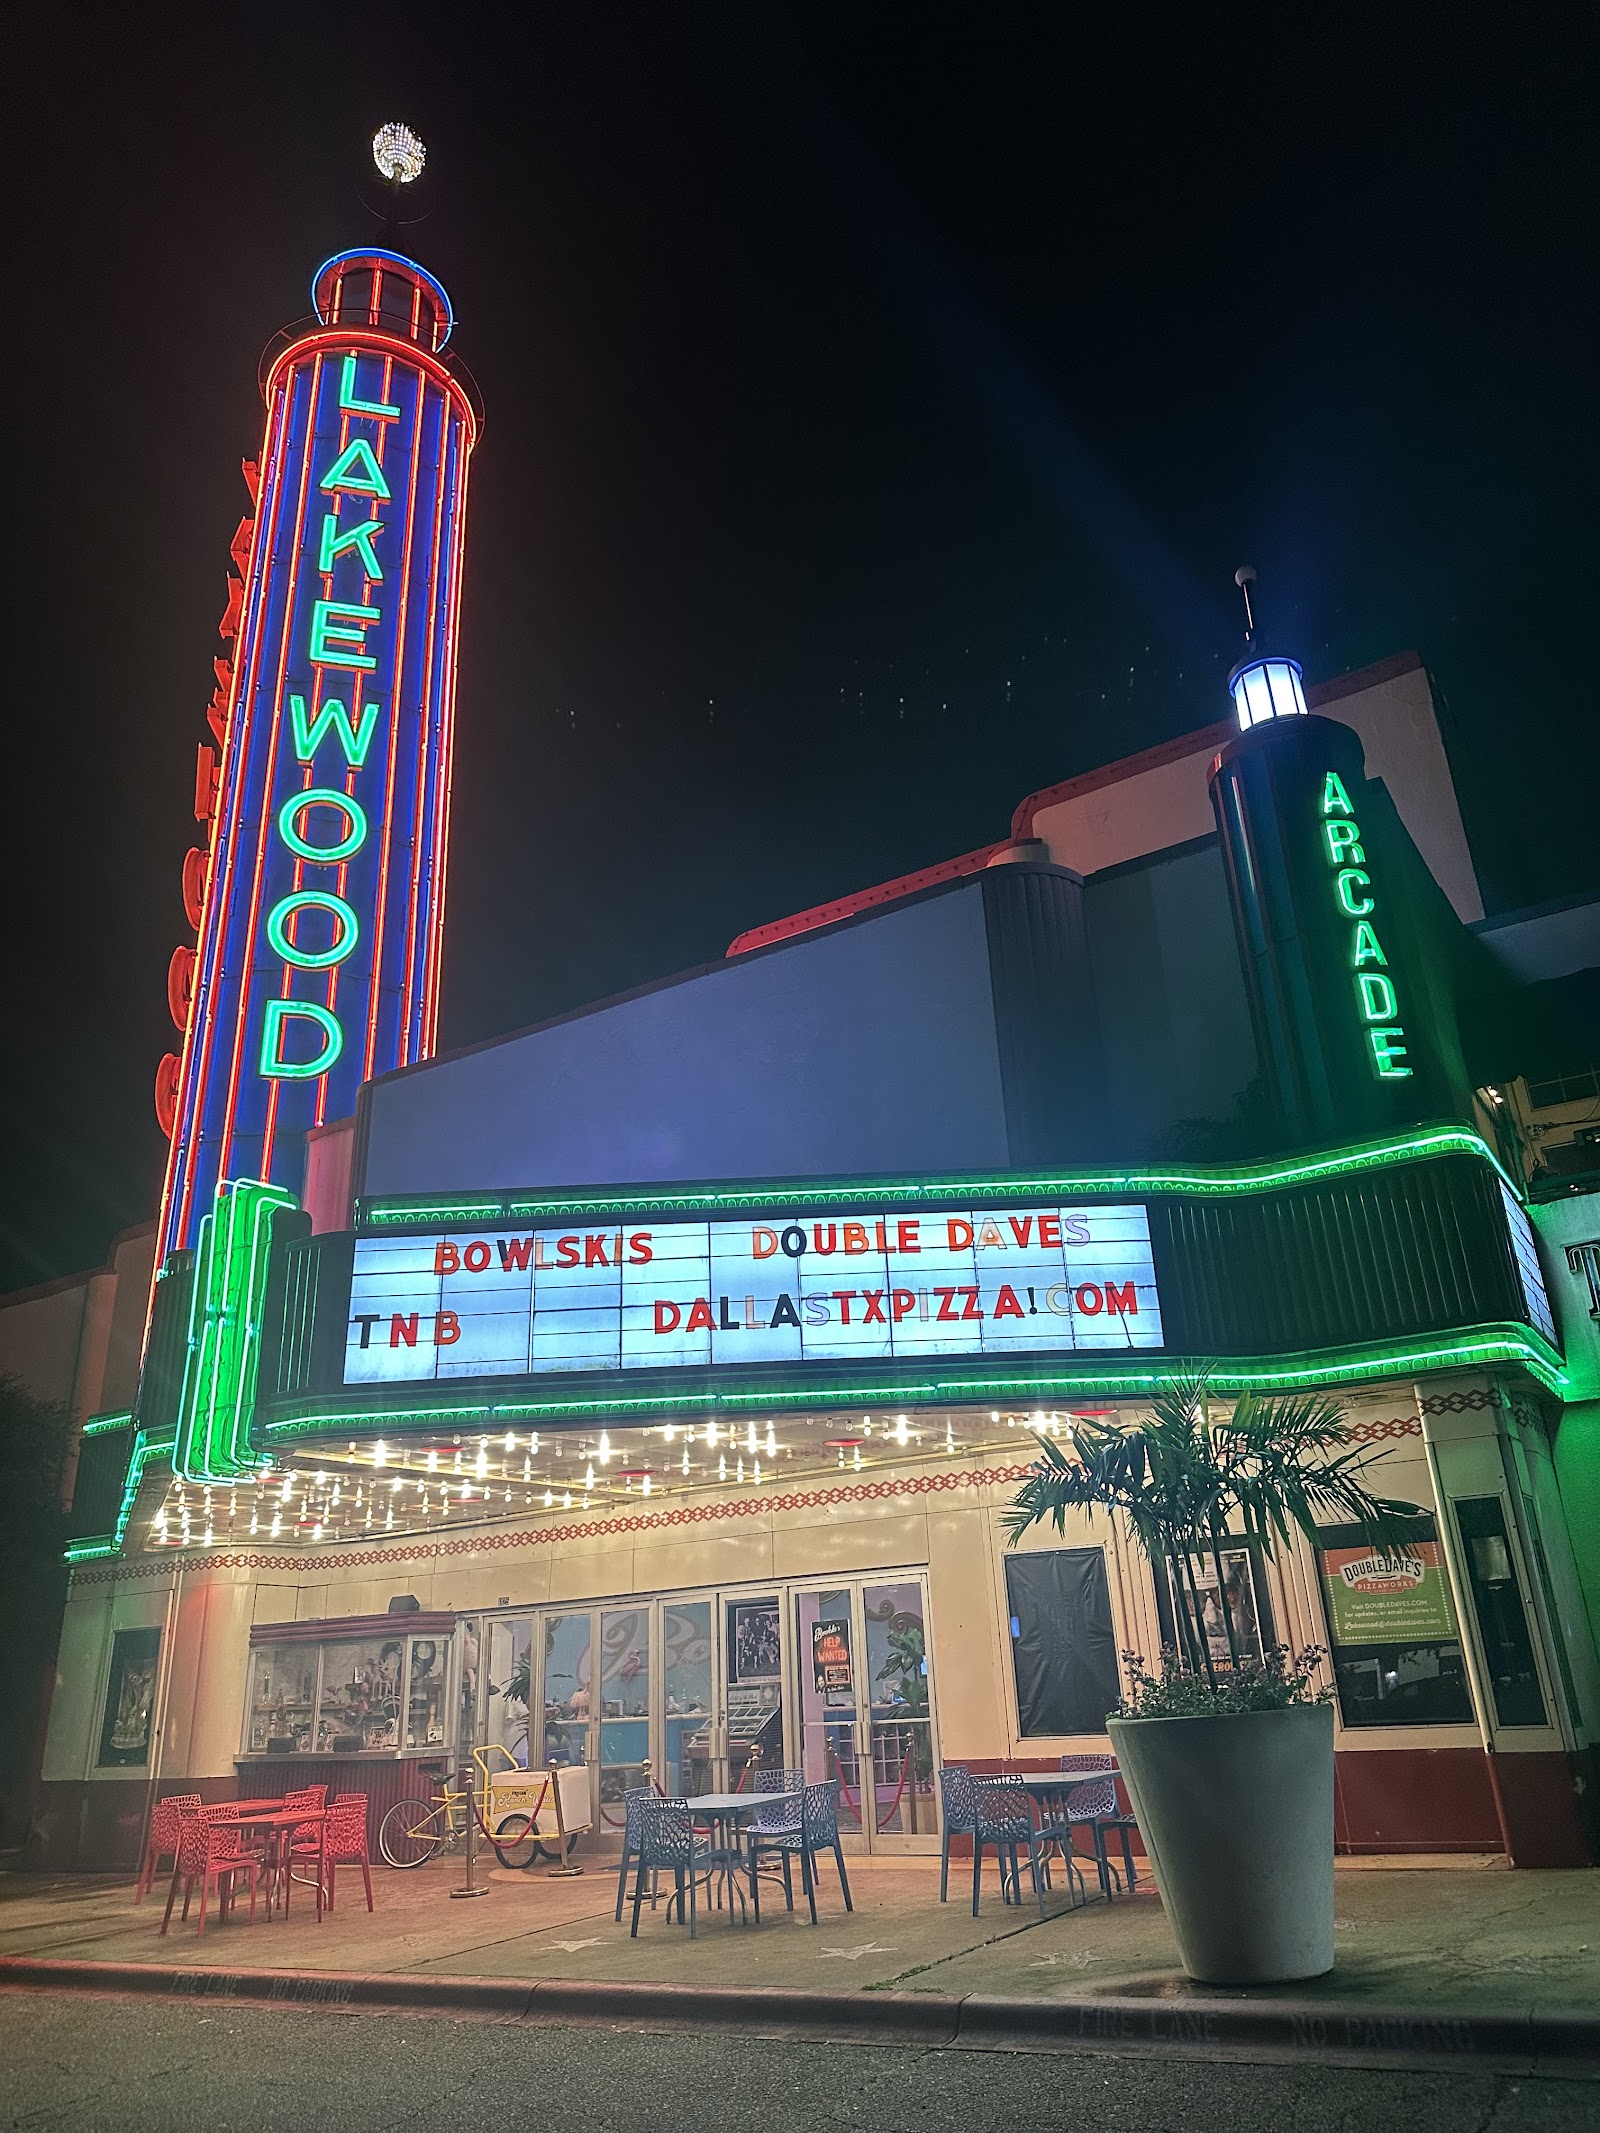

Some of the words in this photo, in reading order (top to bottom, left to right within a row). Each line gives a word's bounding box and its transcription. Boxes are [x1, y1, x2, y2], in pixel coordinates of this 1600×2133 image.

[259, 355, 401, 1080] LAKEWOOD
[1320, 770, 1414, 1079] ARCADE
[752, 1219, 922, 1260] DOUBLE
[947, 1213, 1091, 1252] DAVES
[434, 1231, 654, 1276] BOWLSKIS
[1357, 1580, 1414, 1590] PIZZAWORKS
[1364, 1600, 1428, 1609] DOUBLEDAVES.COM
[817, 1649, 848, 1662] WANTED
[823, 1636, 841, 1648] HELP
